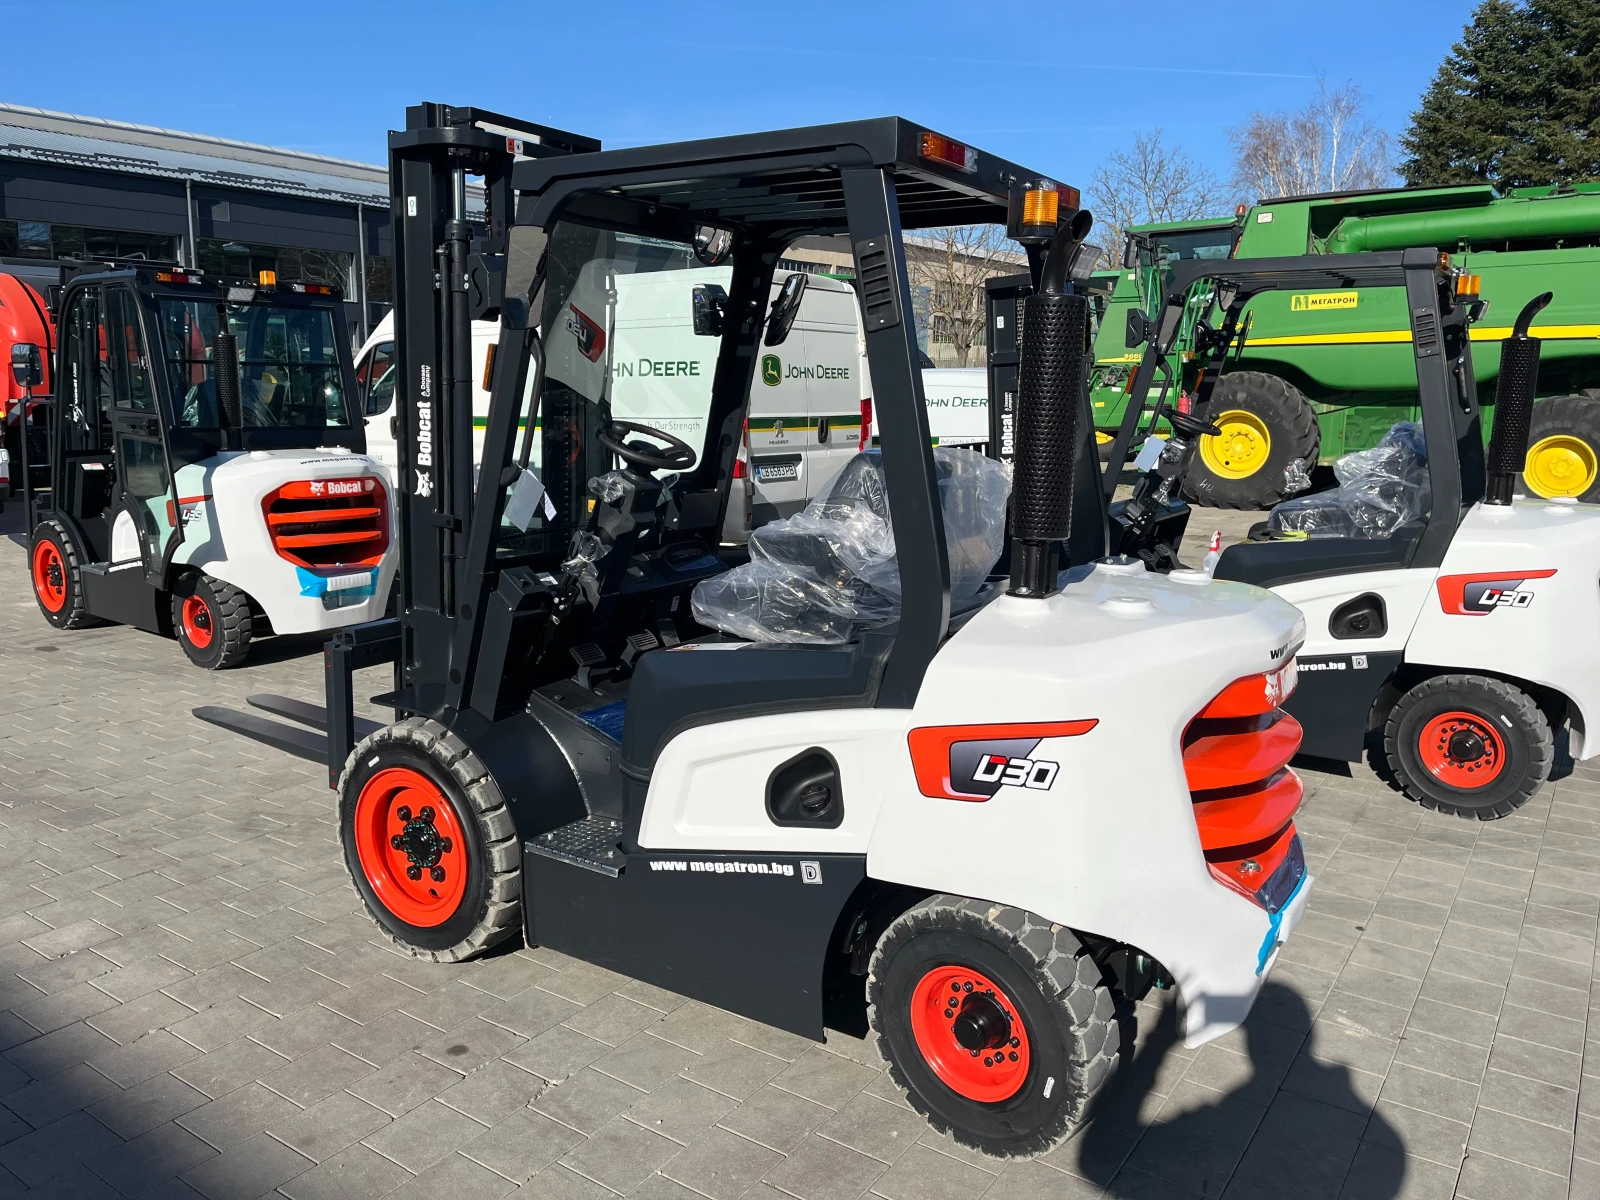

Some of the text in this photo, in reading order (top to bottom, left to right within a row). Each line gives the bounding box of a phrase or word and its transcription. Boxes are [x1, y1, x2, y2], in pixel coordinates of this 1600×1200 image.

[612, 358, 700, 377] HN DEERE
[785, 363, 850, 379] JOHN DEERE
[925, 396, 989, 408] OHN DEER
[416, 400, 432, 466] Bobcat
[668, 420, 700, 432] Strength
[1001, 413, 1014, 454] Bobcat
[328, 481, 362, 495] Bobcat
[1478, 588, 1535, 609] D30
[1296, 661, 1347, 672] tron.bg
[972, 754, 1060, 791] D30
[650, 861, 687, 871] www
[690, 861, 794, 877] megatron.bg
